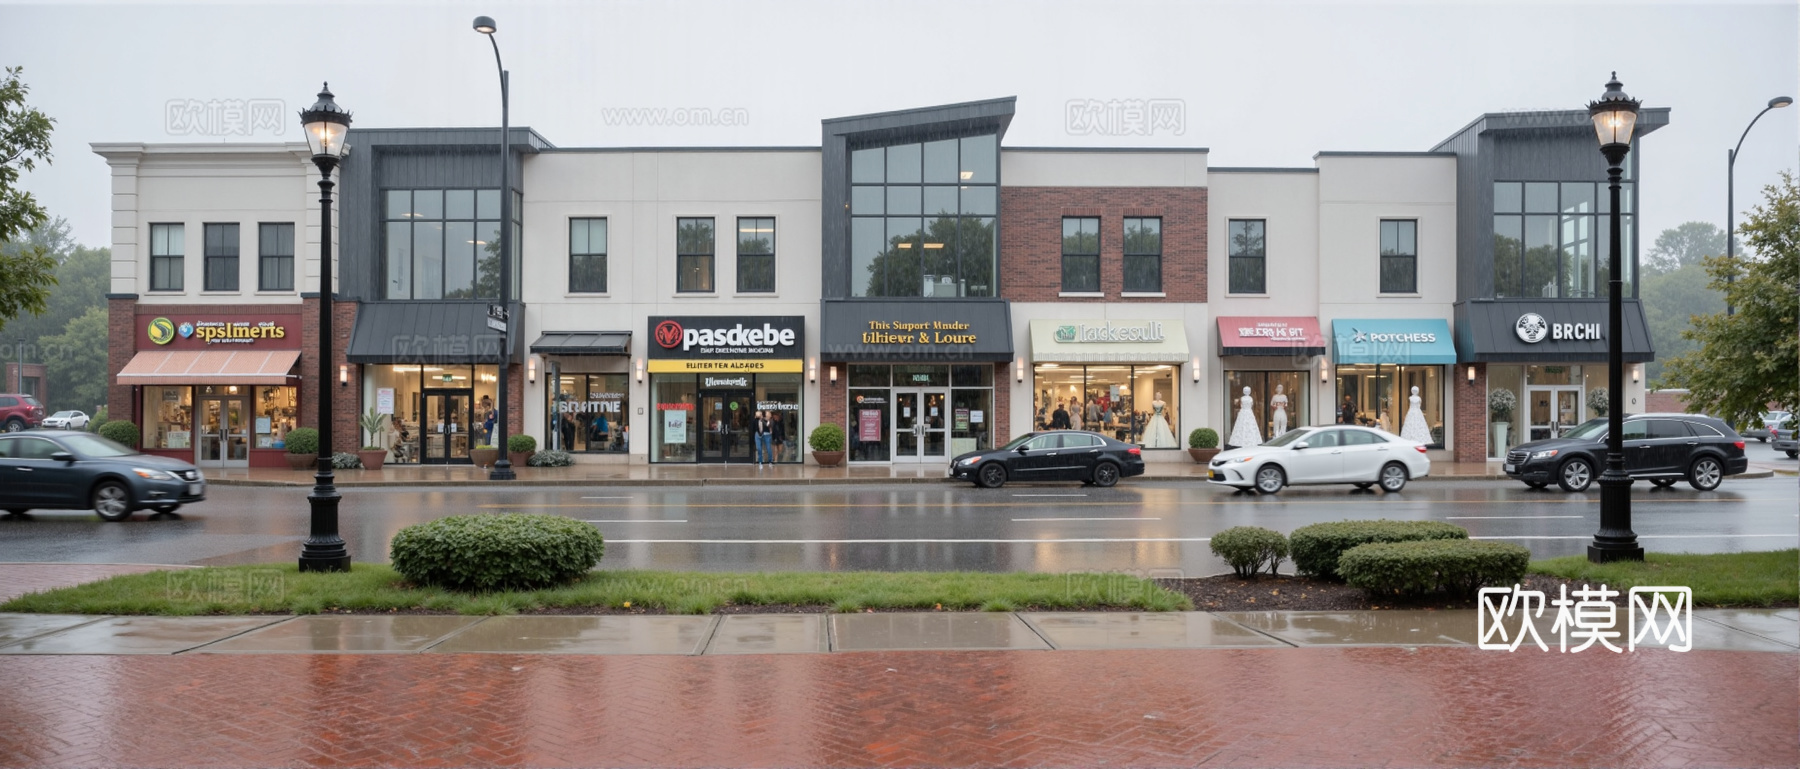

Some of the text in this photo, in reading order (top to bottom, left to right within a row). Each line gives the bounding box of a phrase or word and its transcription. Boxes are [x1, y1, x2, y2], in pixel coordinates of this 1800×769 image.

[1552, 323, 1601, 340] BRCHI
[919, 332, 930, 344] &
[1370, 333, 1436, 343] POTCHESS
